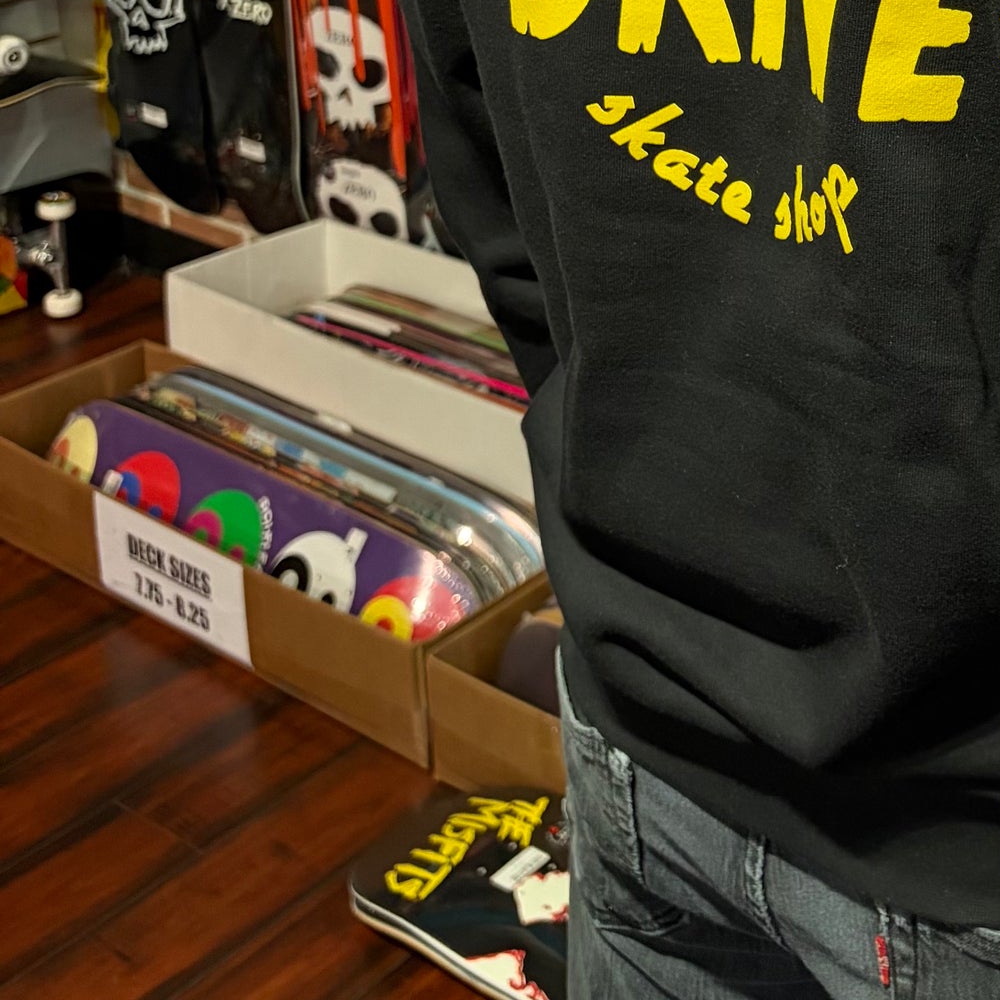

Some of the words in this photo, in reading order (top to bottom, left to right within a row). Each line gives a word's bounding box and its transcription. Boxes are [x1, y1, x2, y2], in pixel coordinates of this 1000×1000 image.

[586, 95, 753, 224] skate
[774, 163, 858, 254] shop
[127, 533, 166, 574] DECK
[169, 554, 211, 596] SIZES
[135, 572, 163, 607] 7.75
[384, 796, 510, 900] MISFITS
[497, 797, 549, 848] THE
